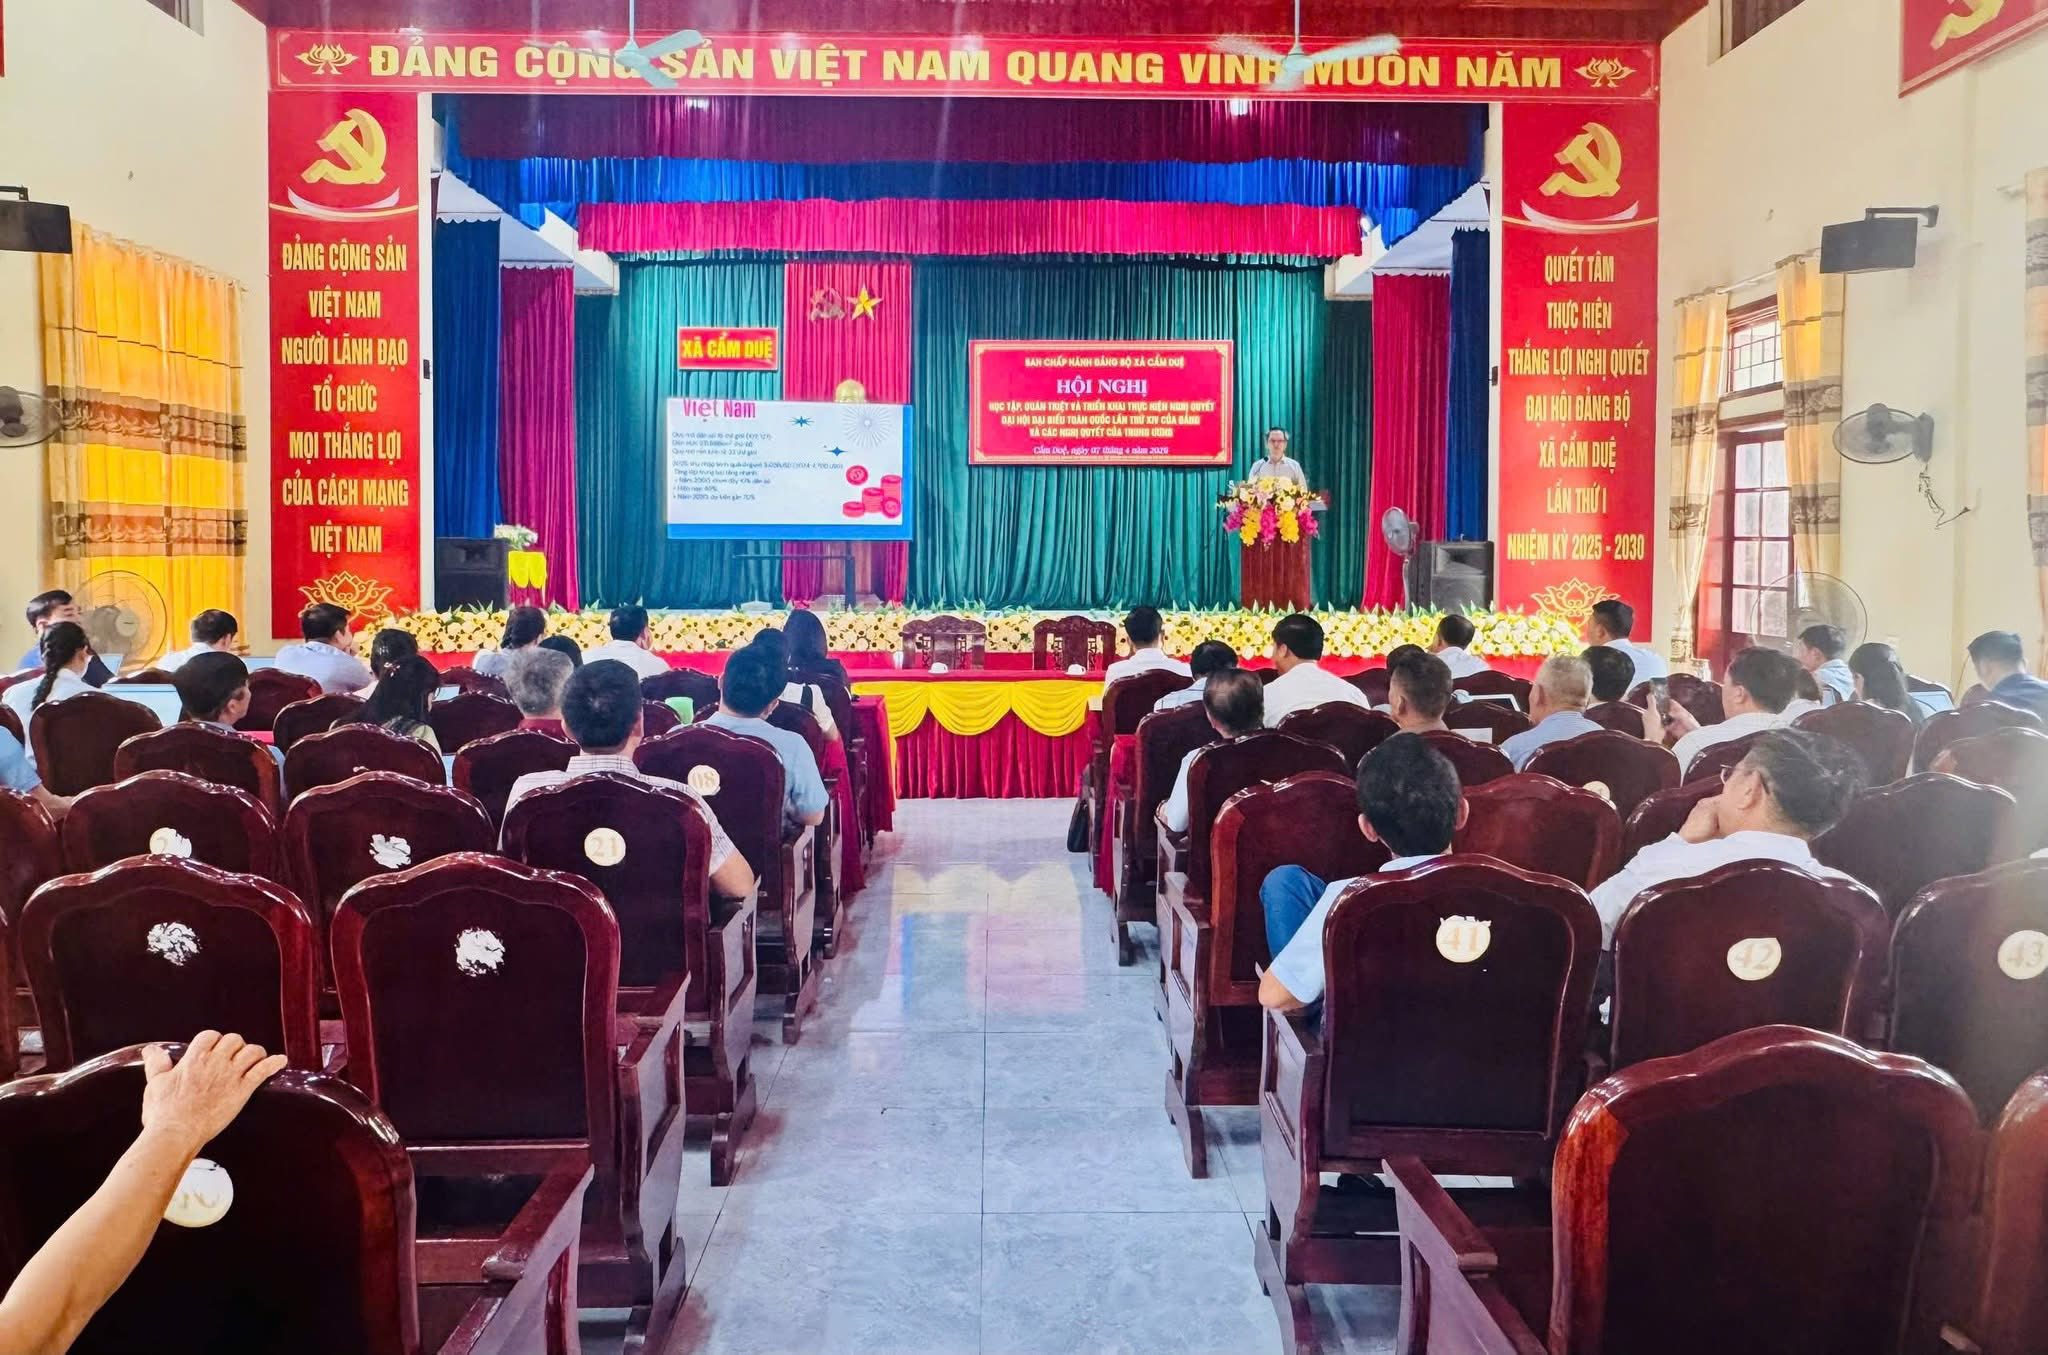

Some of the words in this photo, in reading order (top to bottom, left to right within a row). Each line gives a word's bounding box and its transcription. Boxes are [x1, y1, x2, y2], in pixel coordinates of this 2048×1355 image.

[368, 36, 498, 78] ĐẢNG
[658, 39, 754, 80] SẢN
[769, 43, 867, 88] VIỆT
[882, 50, 989, 82] NAM
[1006, 50, 1164, 84] QUANG
[1455, 47, 1562, 89] NĂM
[282, 233, 325, 271] ĐẢNG
[329, 238, 371, 277] CỘNG
[375, 234, 407, 272] SẢN
[1544, 246, 1584, 286] QUYẾT
[1587, 250, 1615, 283] TÂM
[308, 284, 342, 324] VIỆT
[345, 290, 381, 318] NAM
[1546, 301, 1579, 335] THỰC
[1582, 297, 1612, 335] HIỆN
[281, 331, 329, 365] NGƯỜI
[333, 333, 373, 365] LÃNH
[377, 338, 408, 372] ĐẠO
[682, 335, 704, 359] XÃ
[707, 331, 741, 359] CẨM
[1024, 357, 1042, 368] BAN
[1043, 354, 1067, 368] CHẤP
[1120, 356, 1132, 368] BỘ
[1508, 338, 1549, 375] THẮNG
[1552, 345, 1573, 381] LỢI
[1576, 348, 1607, 381] NGHỊ
[1610, 340, 1650, 376] QUYẾT
[312, 374, 333, 412] TỔ
[336, 379, 377, 412] CHỨC
[1057, 375, 1092, 398] HỘI
[1098, 379, 1148, 398] NGHỊ
[723, 402, 756, 418] Nam
[1525, 394, 1547, 428] ĐẠI
[1550, 390, 1572, 428] HỘI
[1575, 387, 1610, 422] ĐẢNG
[1613, 390, 1631, 428] BỘ
[289, 431, 319, 465] MỌI
[323, 422, 374, 459] THẮNG
[377, 429, 401, 465] LỢI
[1539, 435, 1556, 467] XÃ
[1559, 431, 1588, 467] CẨM
[1592, 436, 1617, 474] DUỆ
[282, 469, 314, 506] CỦA
[317, 472, 358, 506] CÁCH
[362, 479, 409, 512] MẠNG
[1547, 479, 1573, 514] LẦN
[1575, 484, 1600, 514] THỨ
[1602, 487, 1607, 514] I
[309, 519, 342, 559] VIỆT
[346, 526, 382, 553] NAM
[1507, 528, 1550, 566] NHIỆM
[1552, 528, 1568, 561] KỲ
[1572, 533, 1602, 561] 2025
[1614, 533, 1645, 561] 2030
[591, 836, 618, 857] 21
[1441, 927, 1478, 951] 41
[1734, 943, 1774, 970] 42
